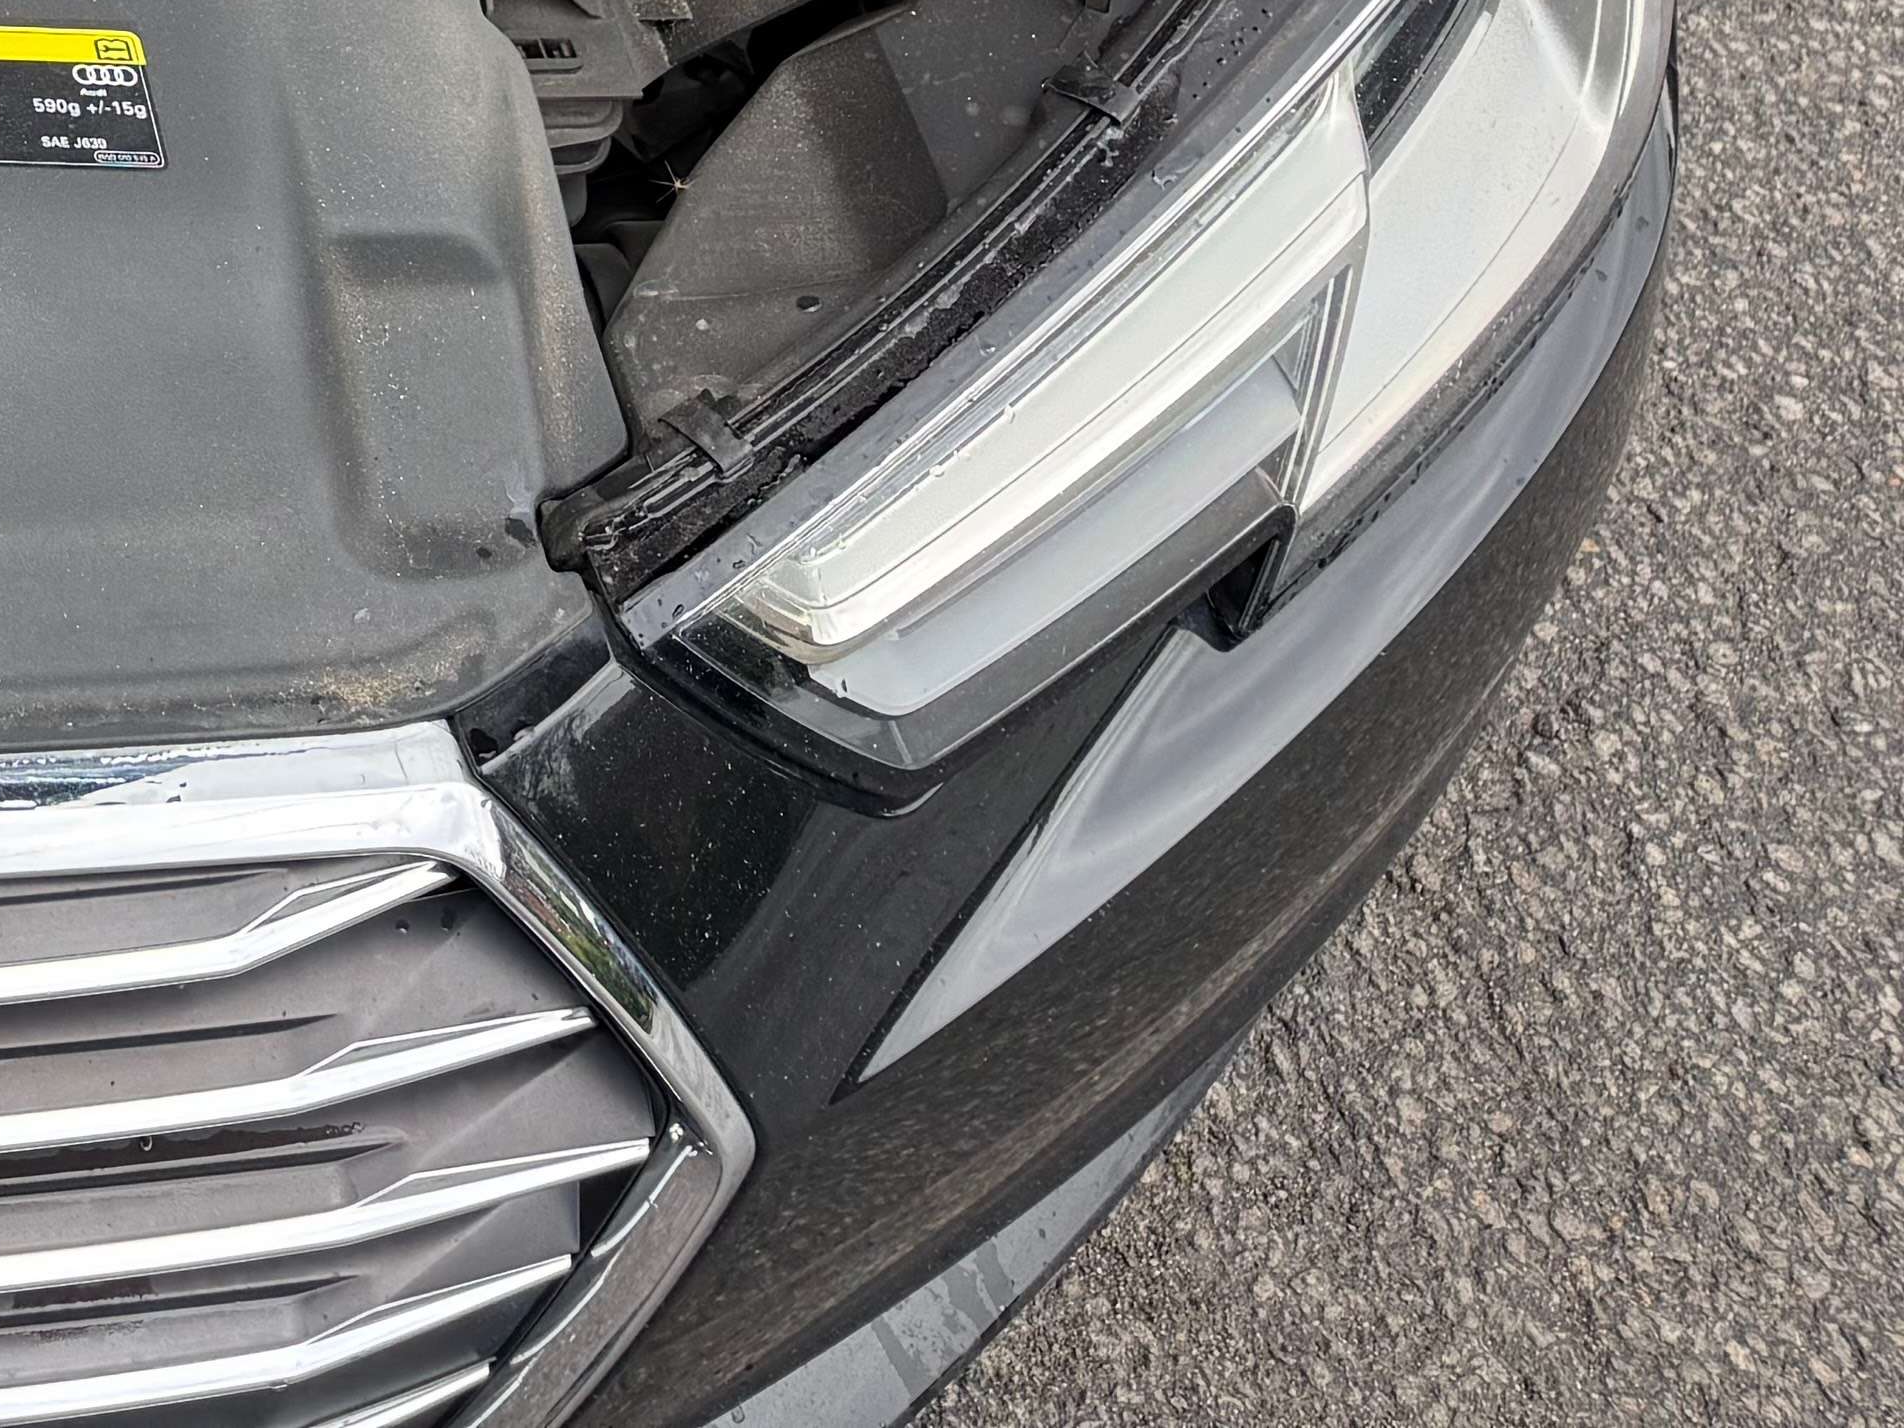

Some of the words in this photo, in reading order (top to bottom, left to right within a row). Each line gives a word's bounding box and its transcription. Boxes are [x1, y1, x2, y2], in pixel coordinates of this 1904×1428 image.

[32, 97, 81, 117] 590g
[86, 99, 148, 120] +/-15g
[40, 135, 71, 149] SAE
